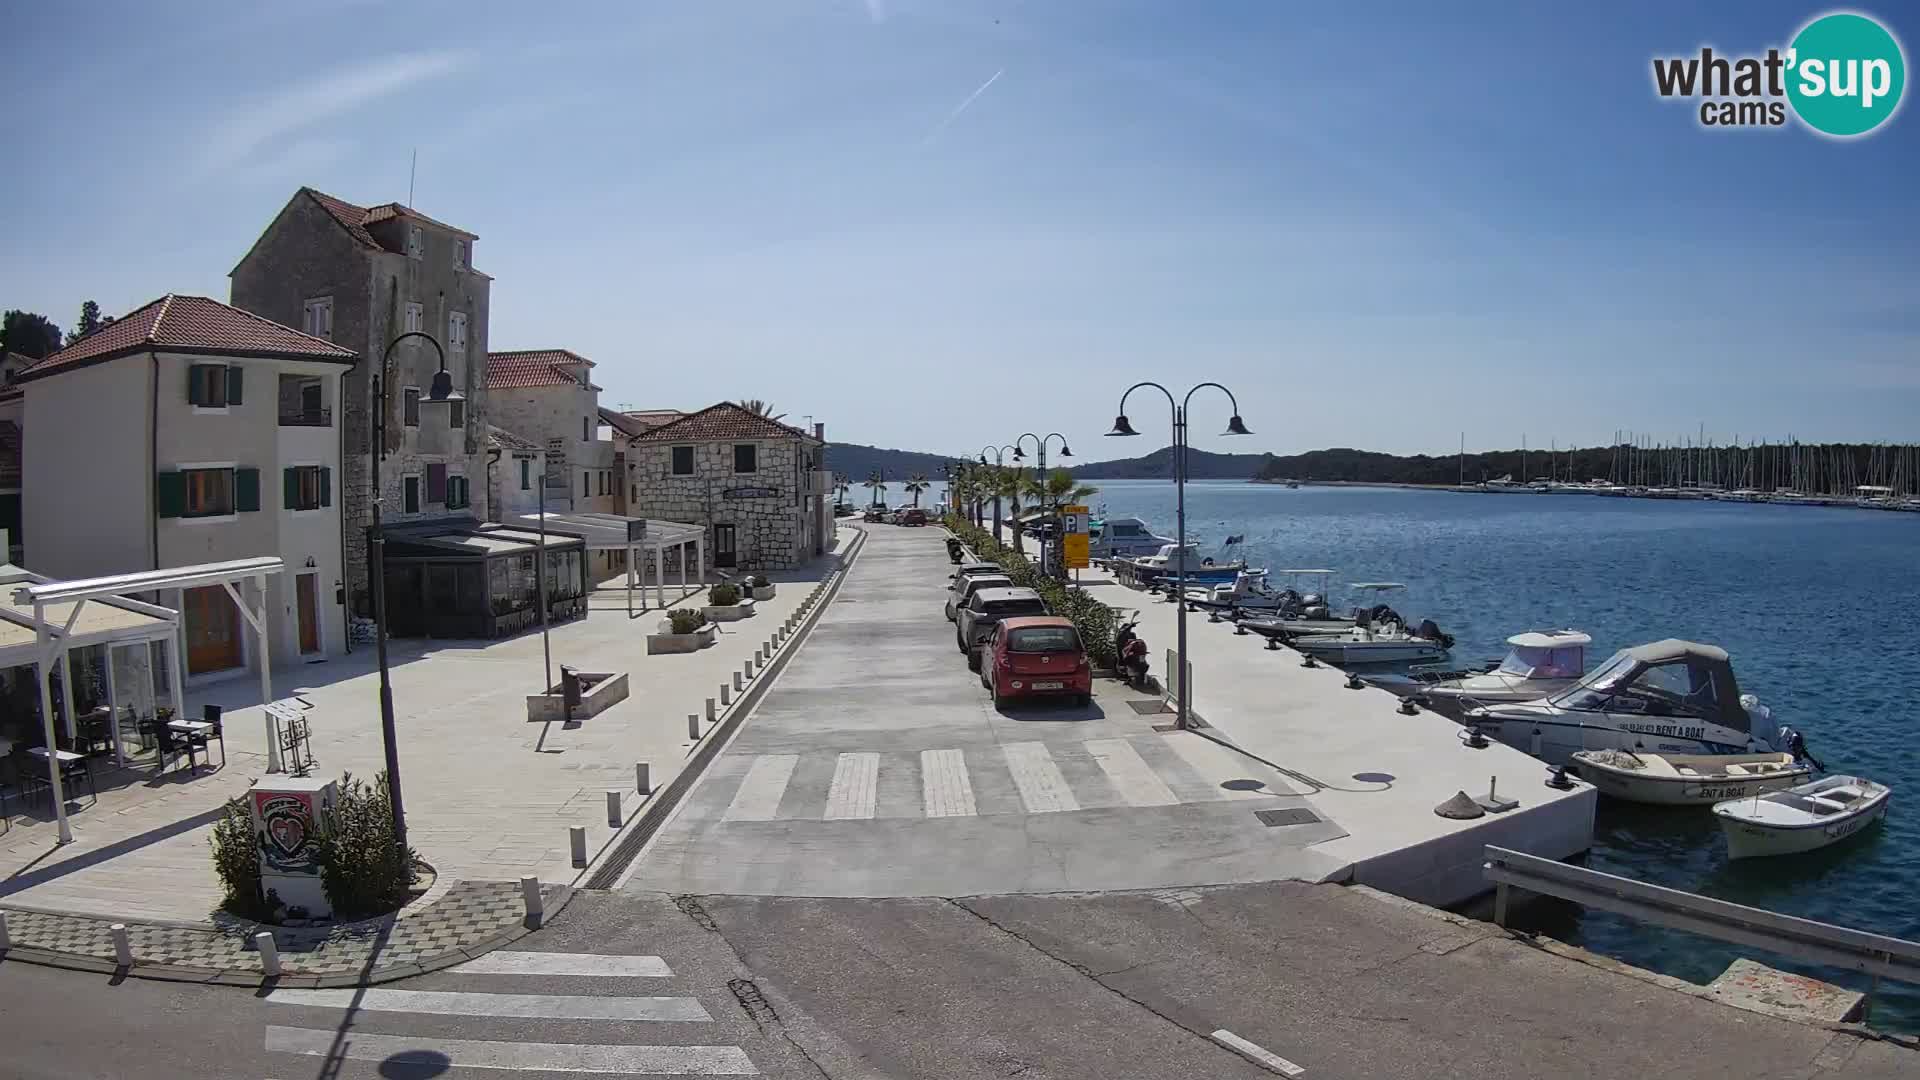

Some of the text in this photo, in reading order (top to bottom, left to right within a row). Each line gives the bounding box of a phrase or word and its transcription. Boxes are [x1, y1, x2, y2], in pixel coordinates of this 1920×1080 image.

[1656, 725, 1677, 736] RENT
[1678, 727, 1683, 736] A
[1685, 727, 1705, 738] BOAT
